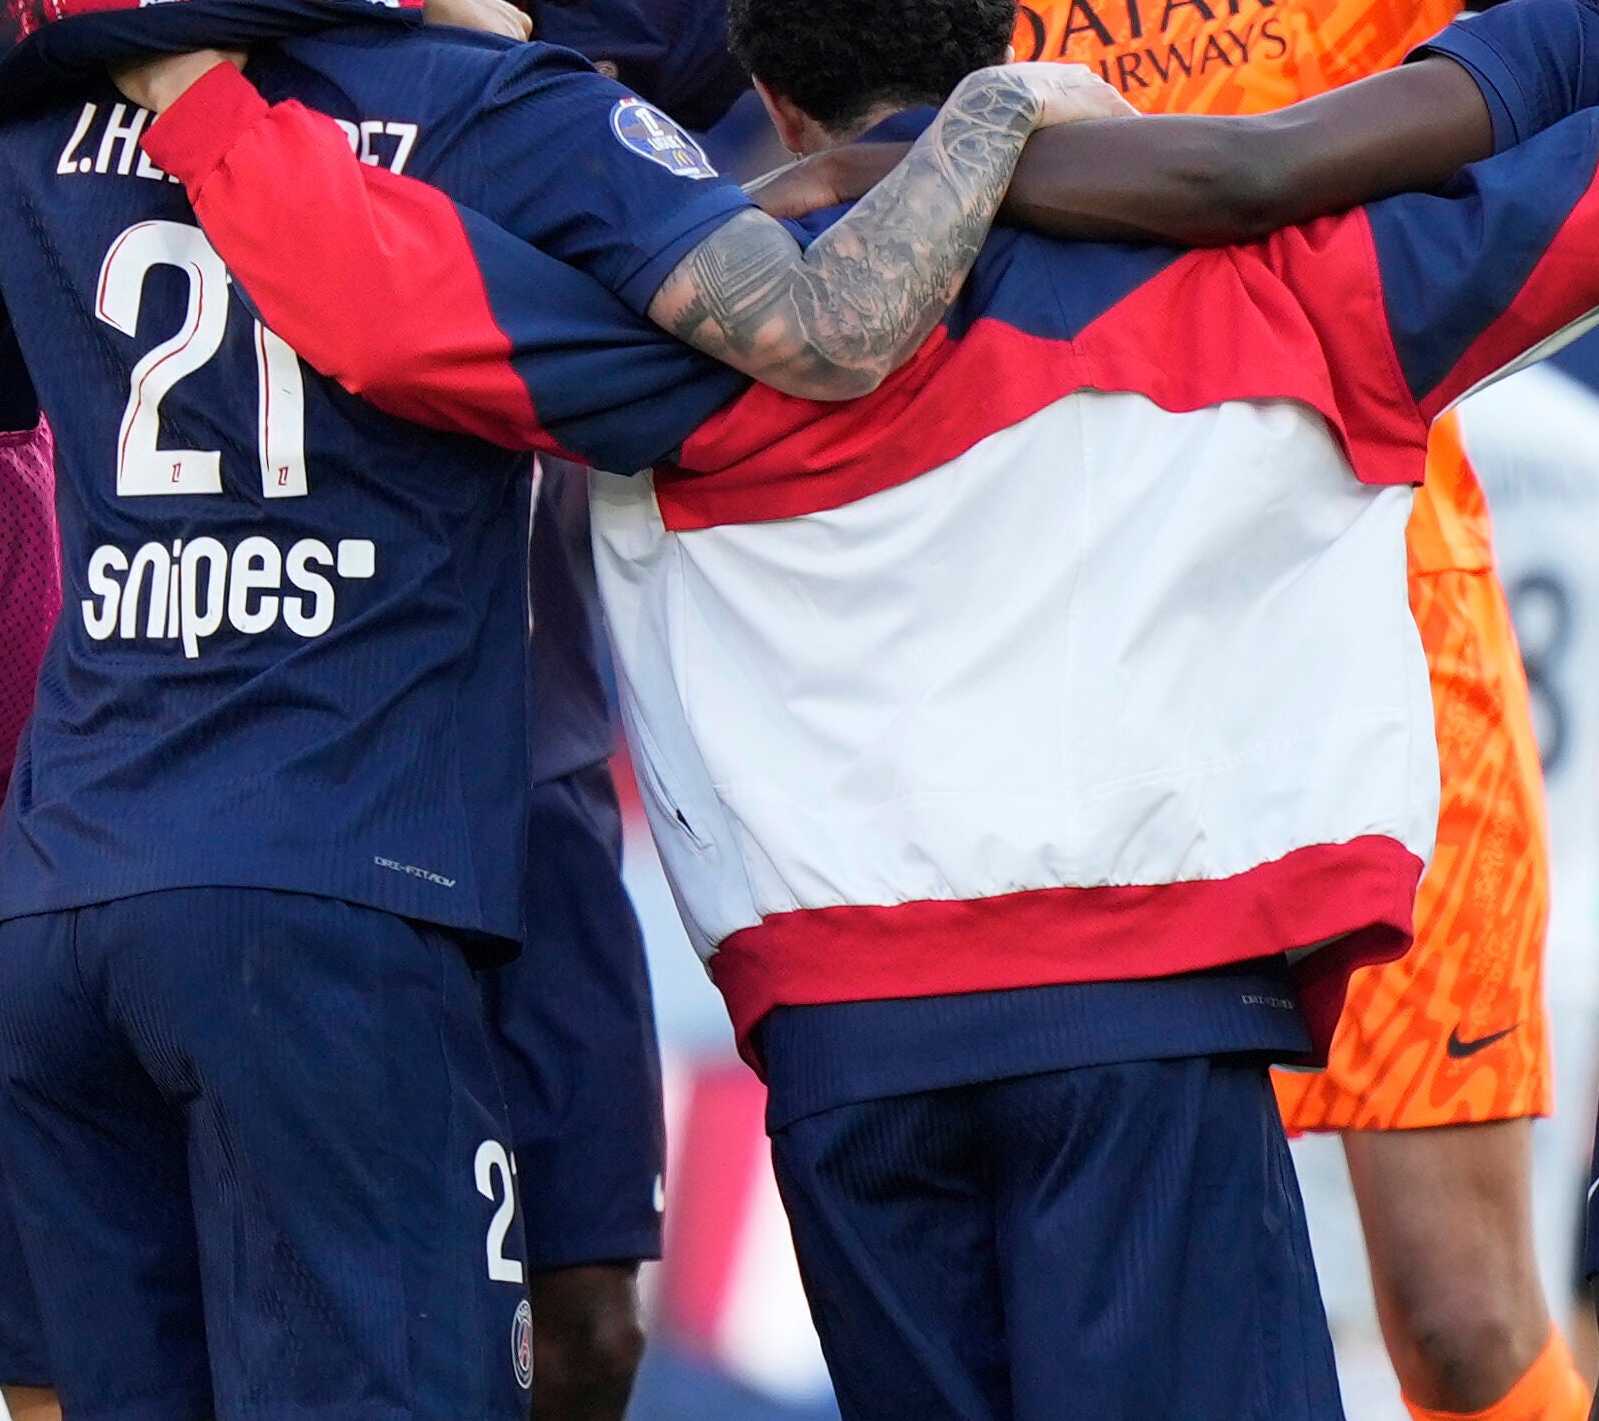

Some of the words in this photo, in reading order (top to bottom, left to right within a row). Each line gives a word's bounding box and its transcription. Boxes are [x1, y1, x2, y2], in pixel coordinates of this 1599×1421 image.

[1099, 17, 1287, 92] IRWAYS
[95, 219, 310, 499] 21
[82, 536, 339, 659] snipes
